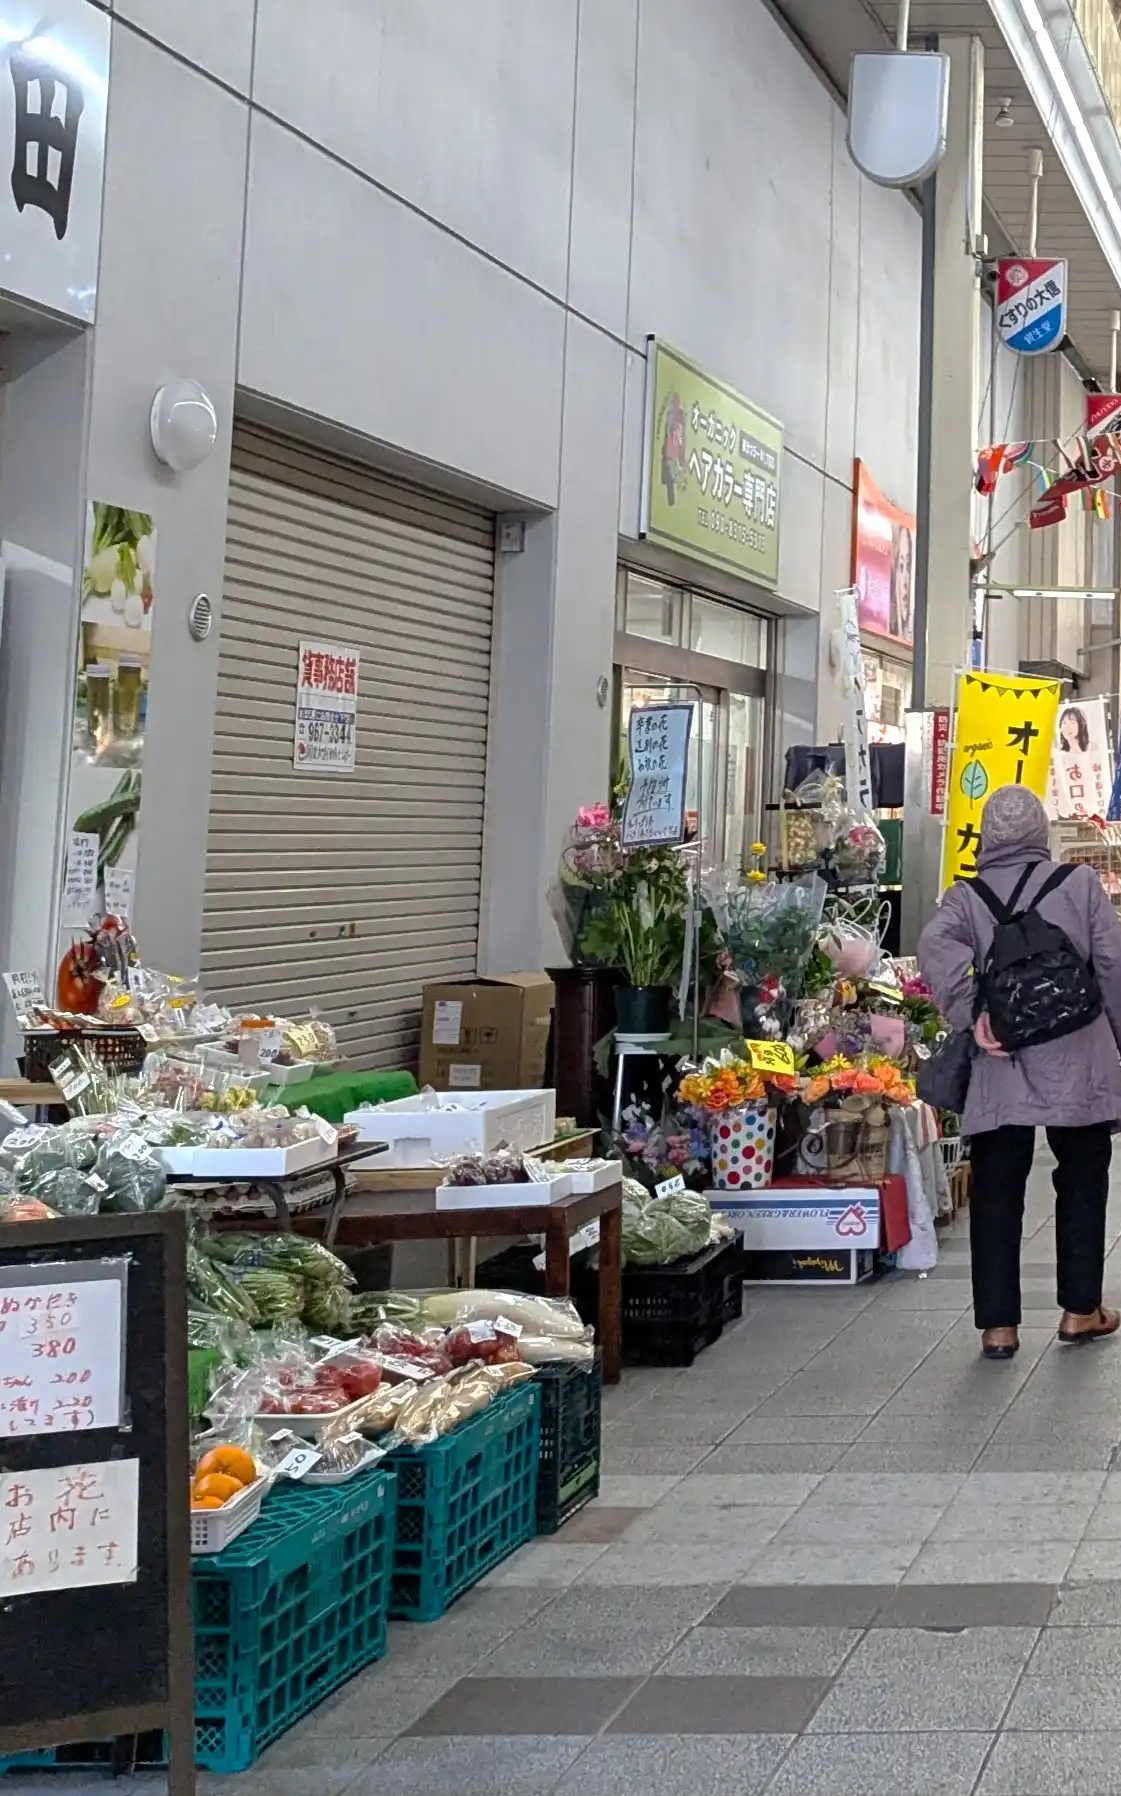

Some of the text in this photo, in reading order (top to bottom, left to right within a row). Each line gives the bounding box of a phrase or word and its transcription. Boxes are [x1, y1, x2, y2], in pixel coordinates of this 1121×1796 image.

[999, 279, 1062, 328] くすりの大信
[691, 401, 738, 454] オーガニック
[689, 449, 777, 531] ヘアカラー専門店
[260, 1048, 278, 1058] 200
[296, 1032, 315, 1046] 250
[26, 1311, 72, 1334] 350
[31, 1336, 77, 1358] 380
[49, 1369, 92, 1384] 200
[7, 1467, 104, 1507] お花
[6, 1508, 111, 1545] 店内に
[11, 1542, 122, 1580] あります
